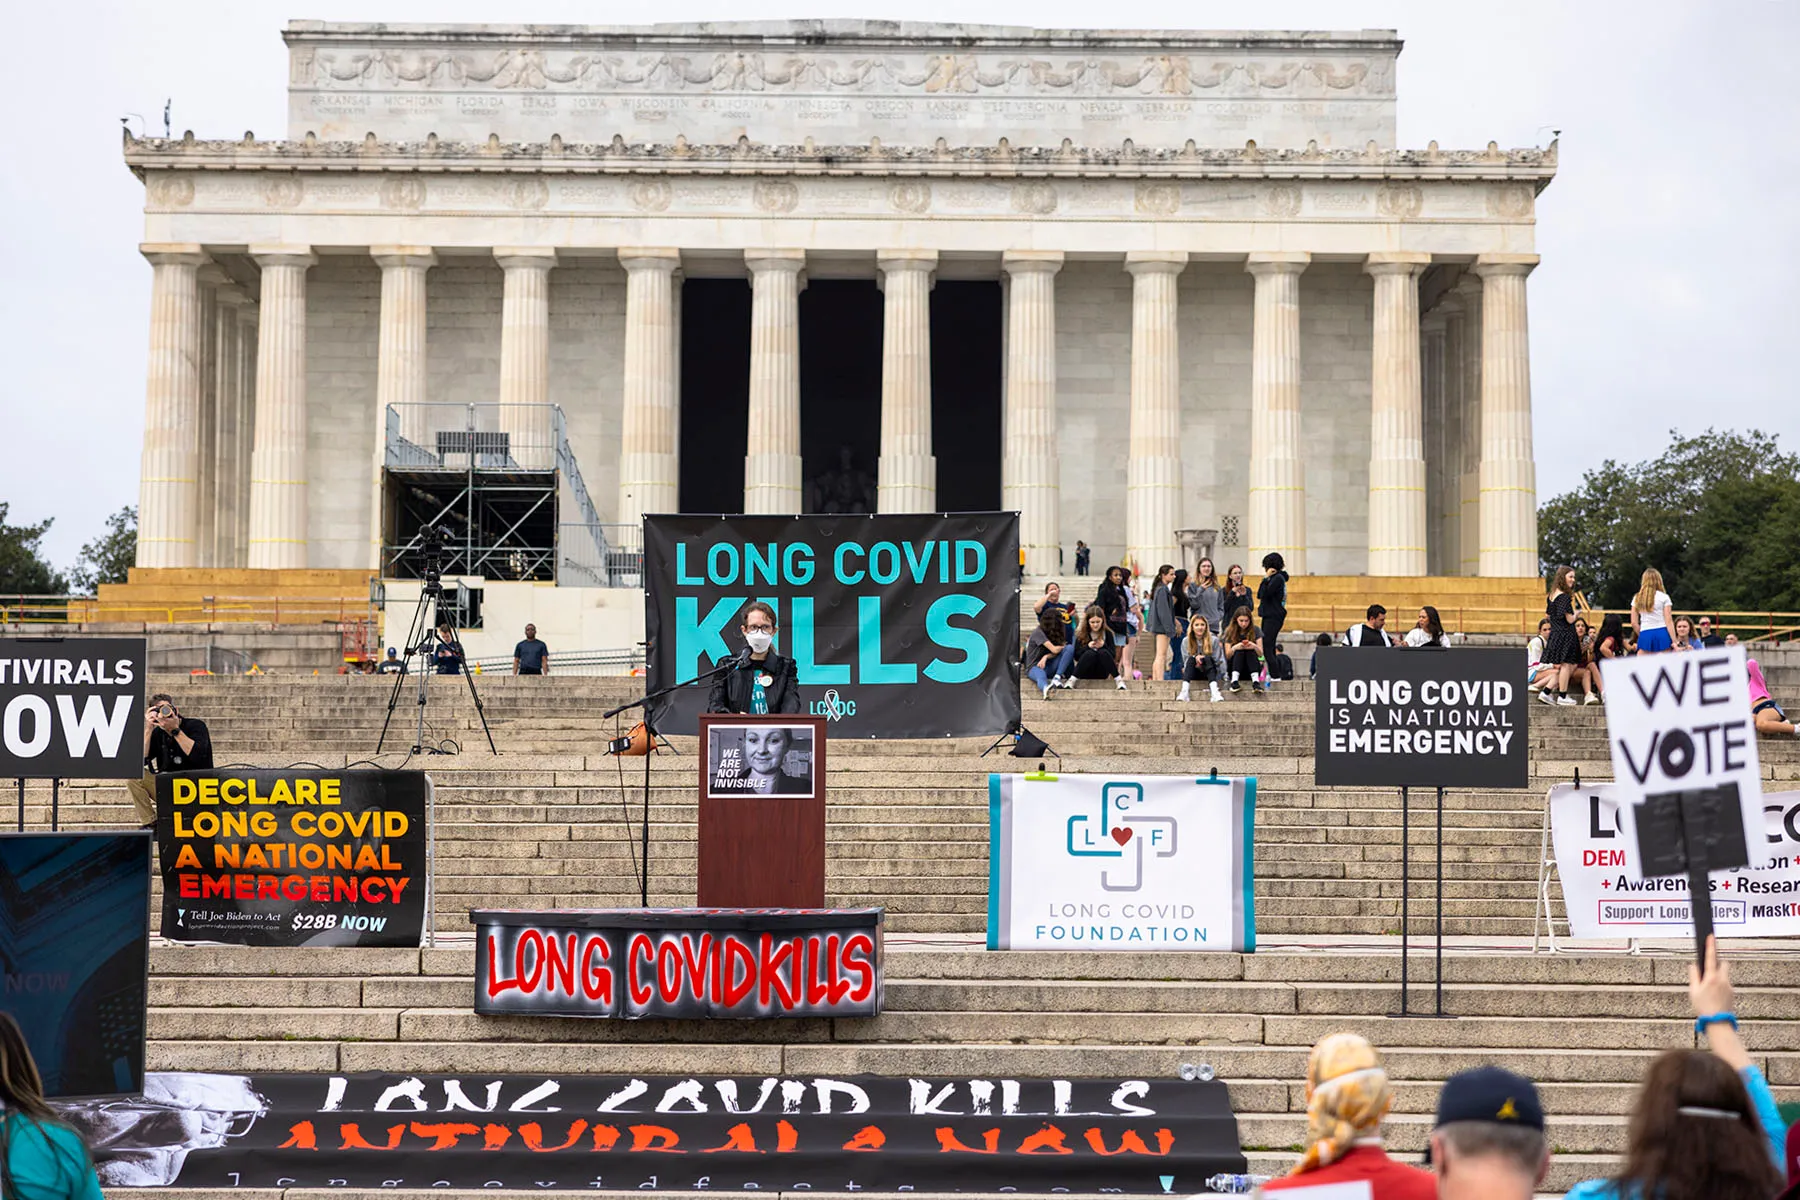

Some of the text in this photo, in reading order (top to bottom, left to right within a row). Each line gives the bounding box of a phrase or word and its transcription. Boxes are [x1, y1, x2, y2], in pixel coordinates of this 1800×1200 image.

[310, 96, 371, 106] ARKANSAS
[383, 96, 443, 106] MICHIGAN
[456, 96, 505, 107] FLORIDA
[521, 97, 557, 108] TEXAS
[573, 98, 607, 108] IOWA
[620, 98, 689, 108] WISCONSIN
[865, 101, 914, 111] OREGON
[926, 101, 969, 112] KANSAS
[676, 540, 987, 586] LONG COVID
[1330, 679, 1513, 706] LONG COVID
[1630, 657, 1730, 710] WE
[3, 694, 134, 758] OW
[1329, 708, 1513, 727] IS A NATIONAL
[1330, 729, 1514, 755] EMERGENCY
[723, 749, 741, 758] WE
[1618, 720, 1746, 785] VOTE
[720, 759, 741, 768] ARE
[717, 769, 741, 778] NOT
[172, 778, 341, 805] DECLARE
[714, 779, 766, 788] INVISIBLE
[1115, 794, 1130, 810] C
[173, 811, 409, 838] LONG COVID
[175, 843, 402, 870] A NATIONAL
[1583, 850, 1626, 867] DEM
[179, 873, 410, 904] EMERGENCY
[1616, 875, 1717, 892] Awarens
[190, 910, 281, 922] Tell Joe Biden to Act
[1050, 903, 1194, 919] LONG COVID
[1604, 904, 1654, 920] Support
[1660, 905, 1689, 920] Long
[291, 913, 388, 932] $28B NOW
[1036, 925, 1207, 942] FOUNDATION
[487, 929, 612, 1007] LONG
[4, 972, 71, 996] NOW
